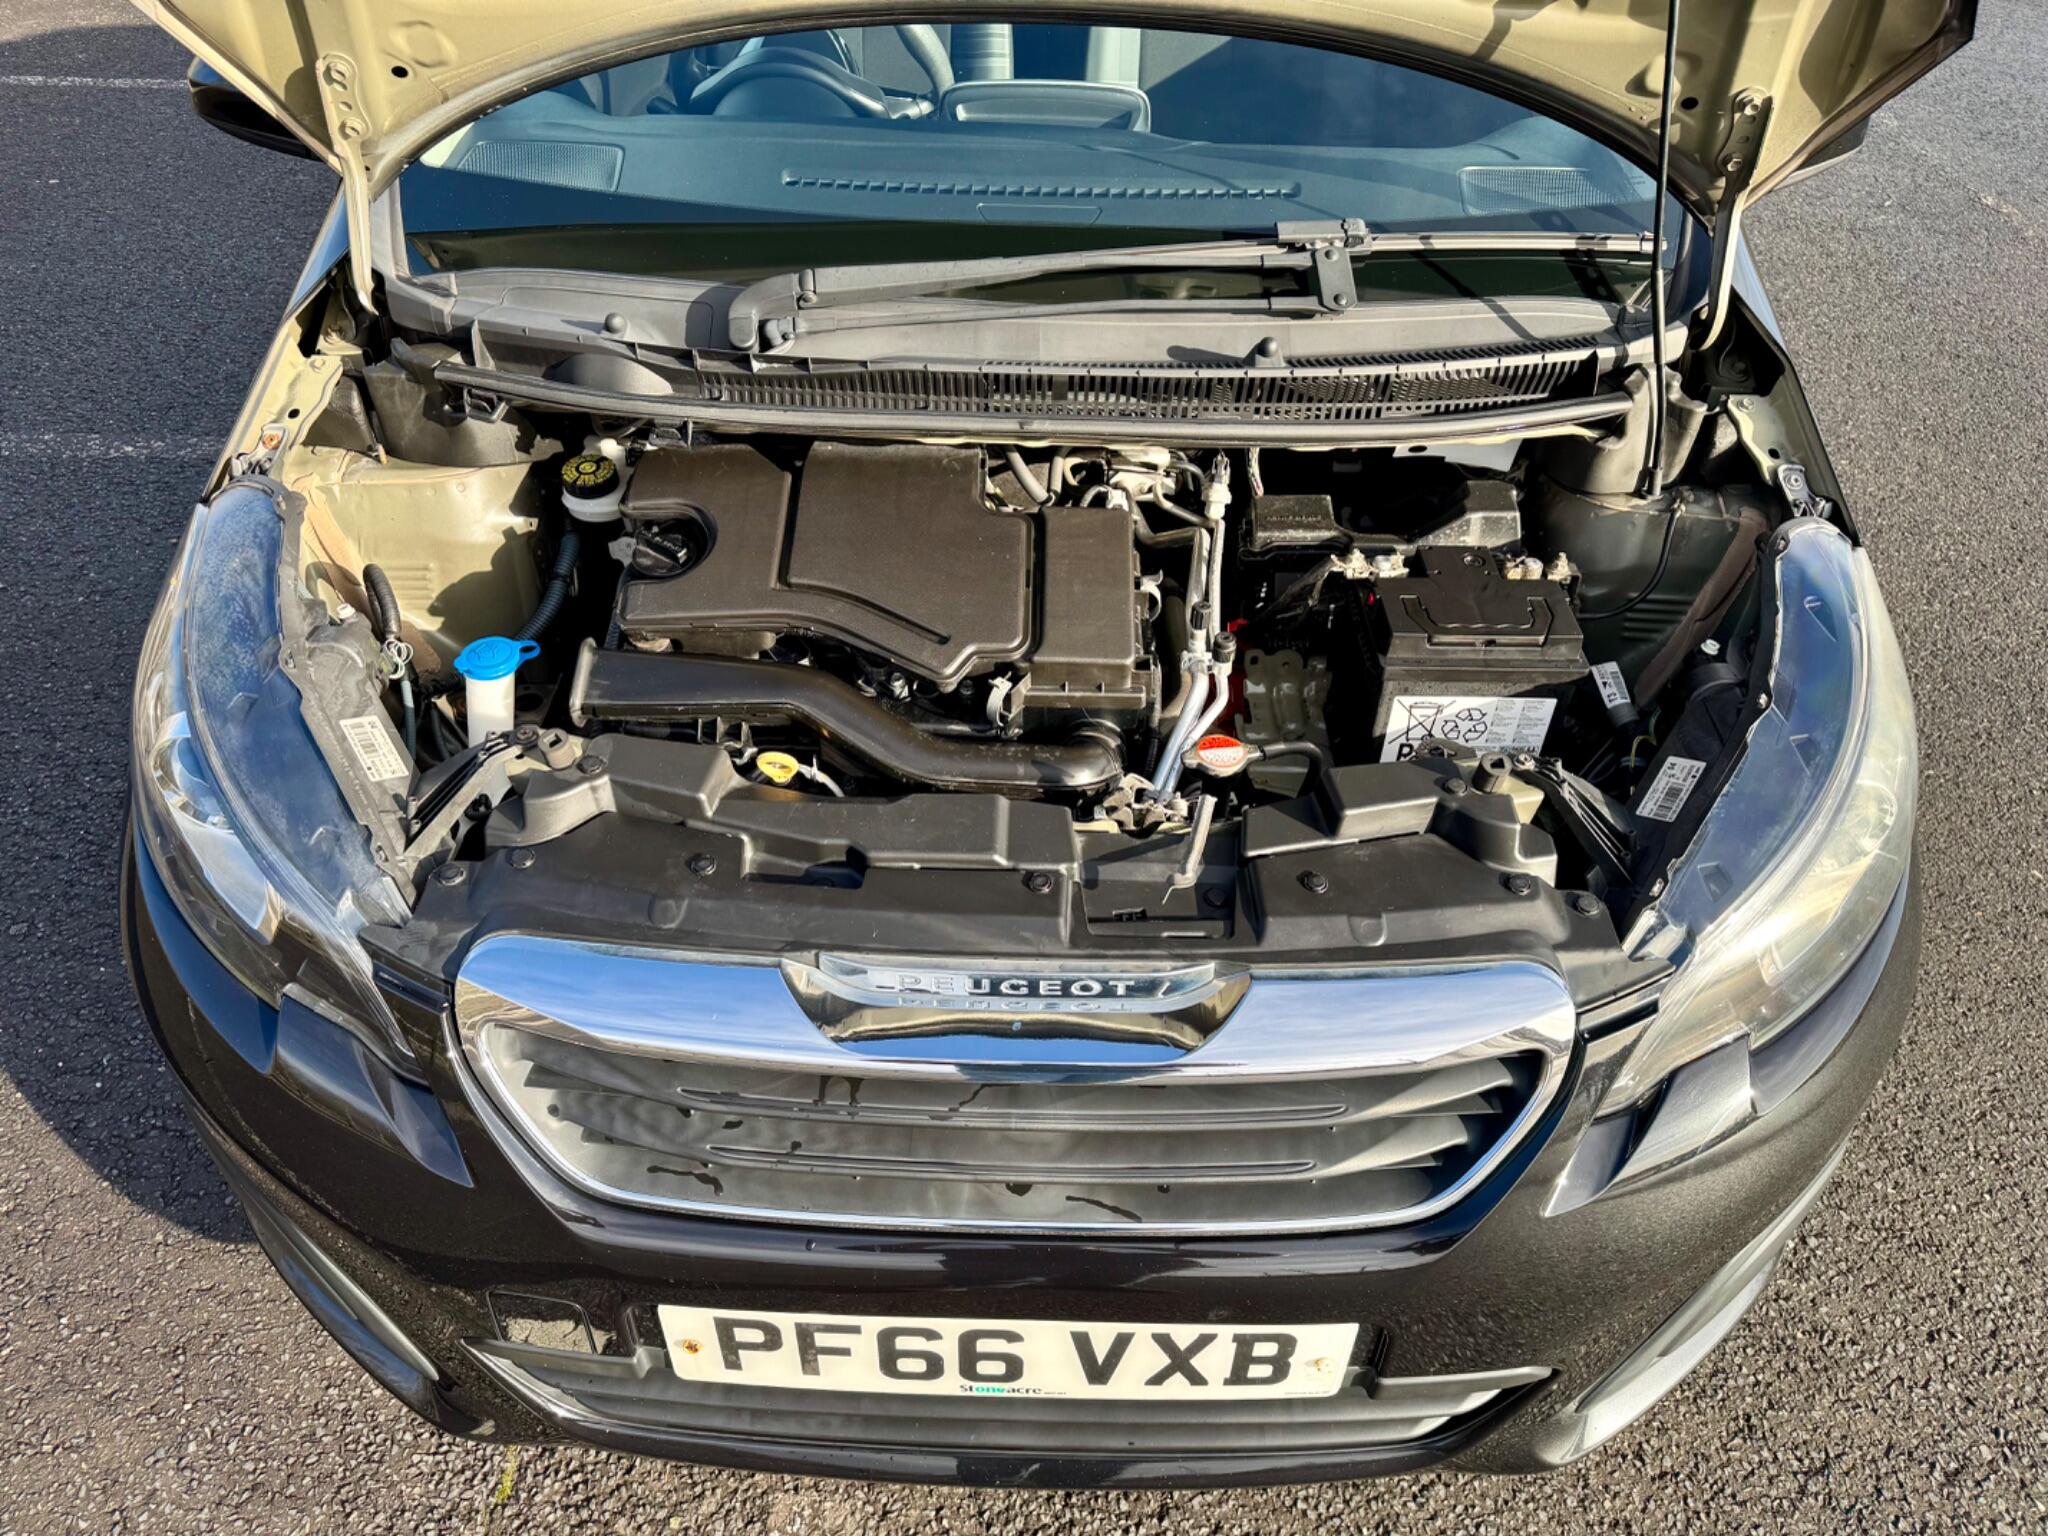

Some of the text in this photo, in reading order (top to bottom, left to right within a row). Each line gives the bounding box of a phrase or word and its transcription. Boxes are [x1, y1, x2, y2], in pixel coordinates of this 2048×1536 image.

[897, 974, 1135, 997] PEUGEOT
[712, 1317, 1299, 1386] PF66 VXB
[959, 1384, 1043, 1395] Stoneacre
